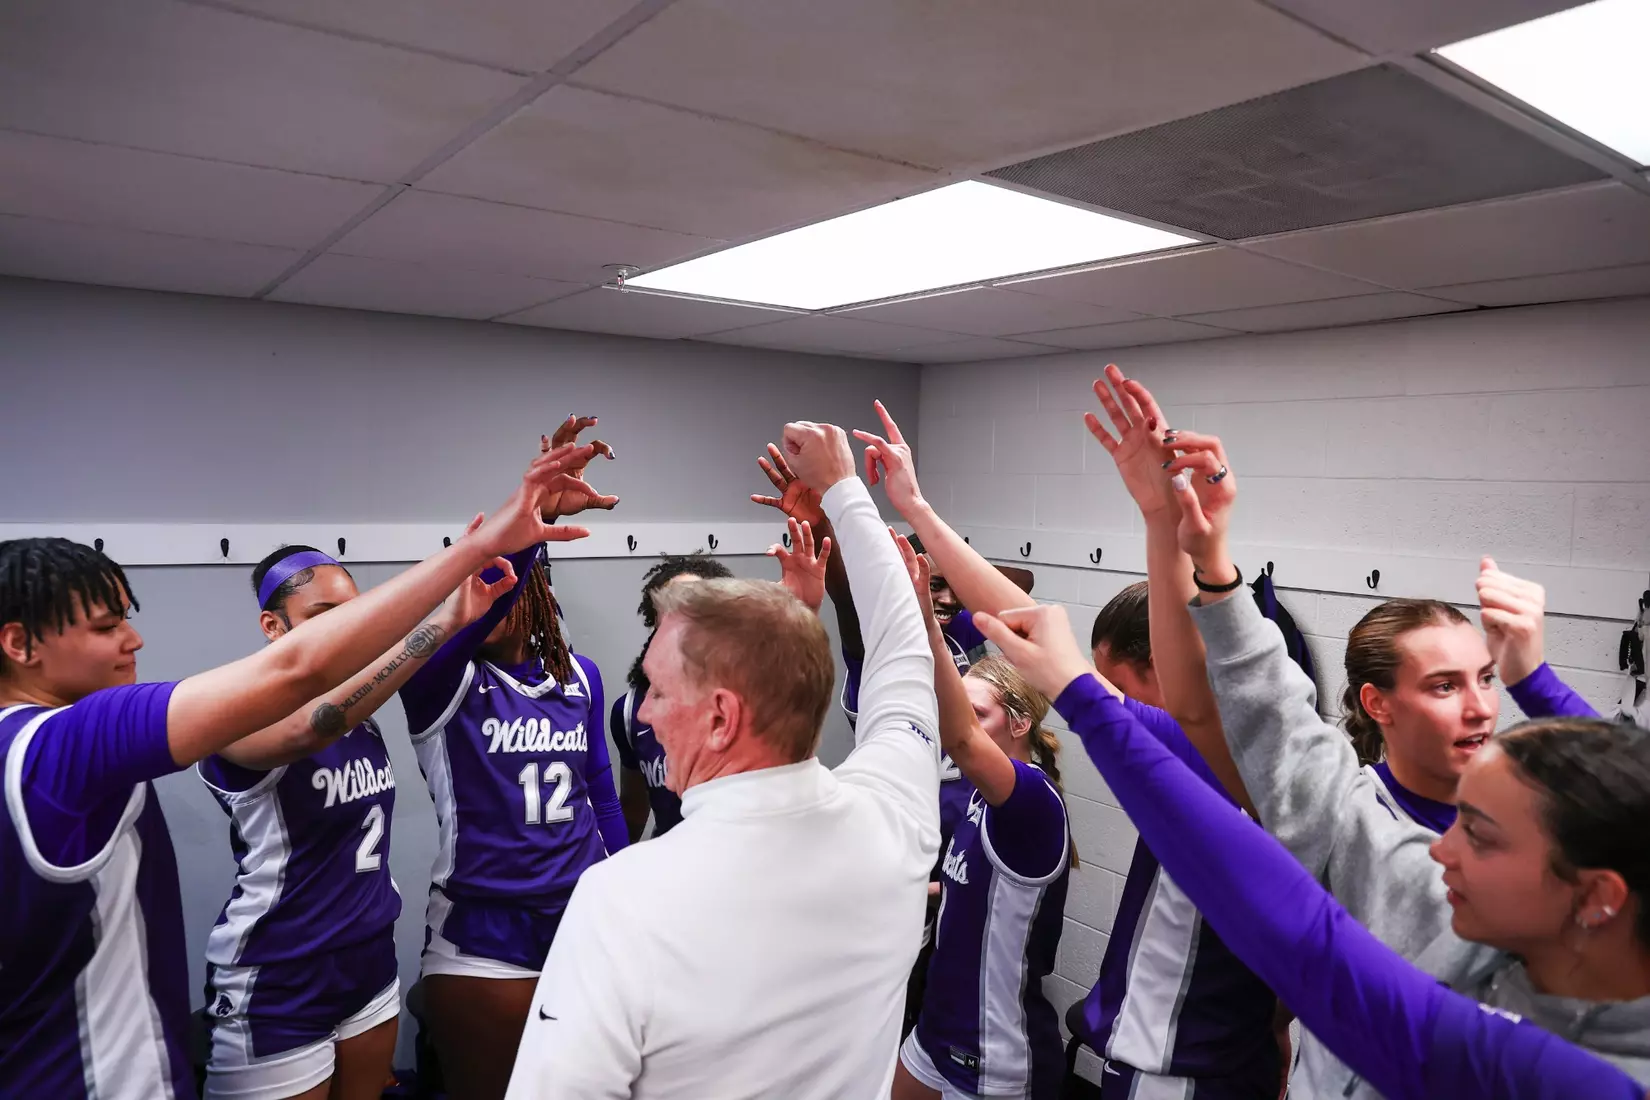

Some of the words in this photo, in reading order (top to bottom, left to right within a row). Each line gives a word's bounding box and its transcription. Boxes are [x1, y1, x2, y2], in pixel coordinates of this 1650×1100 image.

[481, 716, 588, 753] Wildcats
[518, 761, 574, 825] 12
[355, 803, 385, 873] 2
